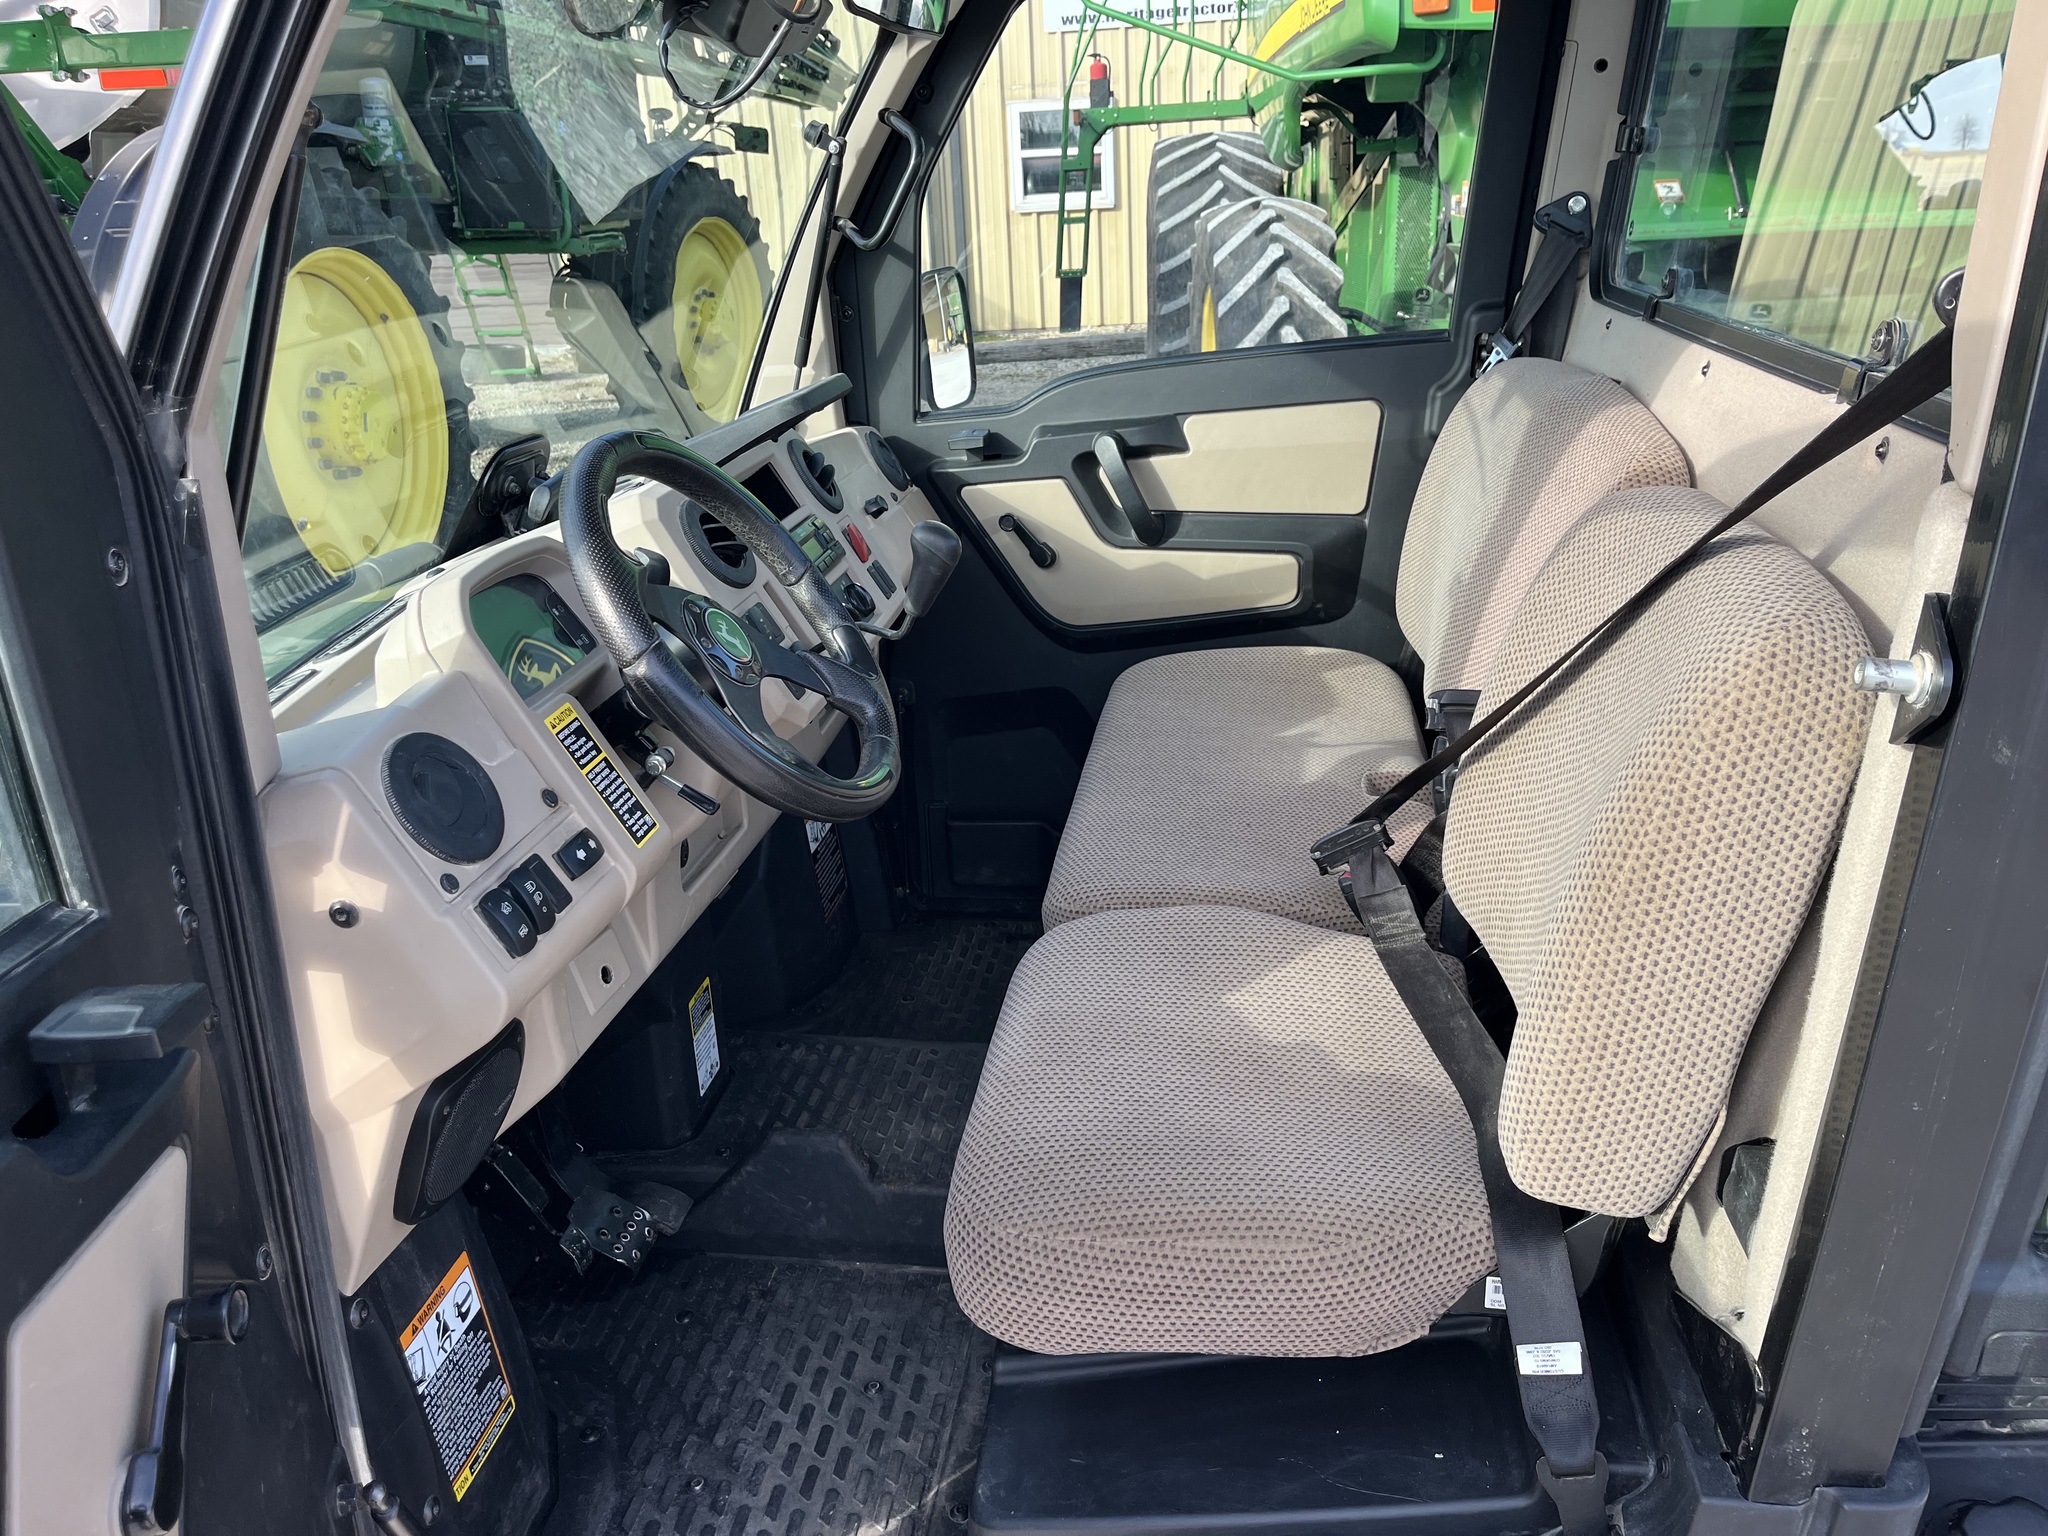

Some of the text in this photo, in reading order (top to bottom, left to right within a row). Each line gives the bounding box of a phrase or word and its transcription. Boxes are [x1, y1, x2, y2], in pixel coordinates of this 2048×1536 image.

[552, 706, 574, 726] CAUTION
[417, 1284, 445, 1326] WARNING
[455, 1472, 469, 1497] TION
